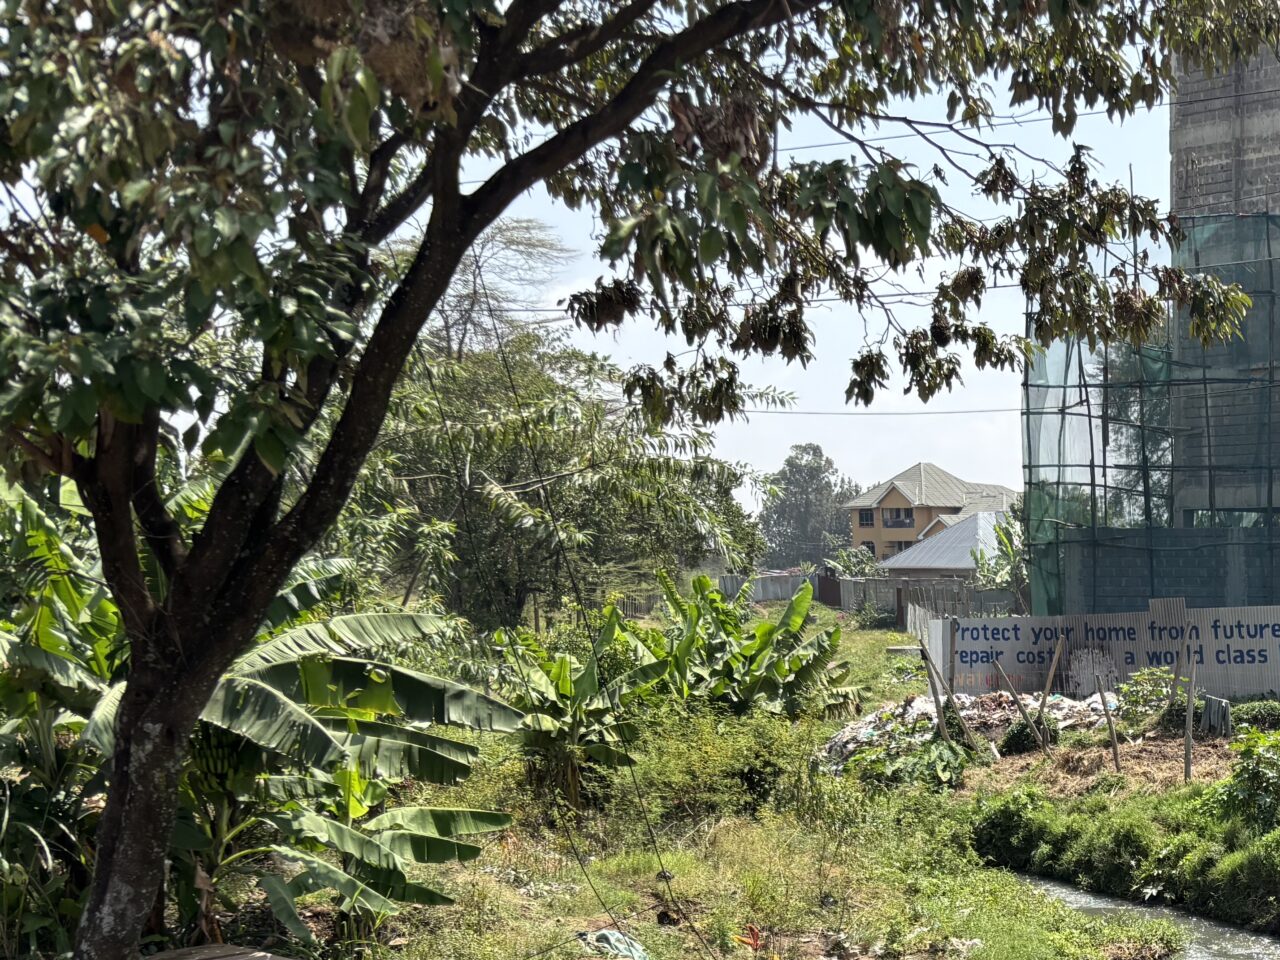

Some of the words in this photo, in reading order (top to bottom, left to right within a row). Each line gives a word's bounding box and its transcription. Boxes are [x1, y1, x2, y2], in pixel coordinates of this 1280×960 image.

[1031, 626, 1074, 645] your
[1084, 622, 1136, 642] home
[1148, 621, 1199, 642] from
[1124, 651, 1135, 666] a
[1215, 644, 1267, 665] class
